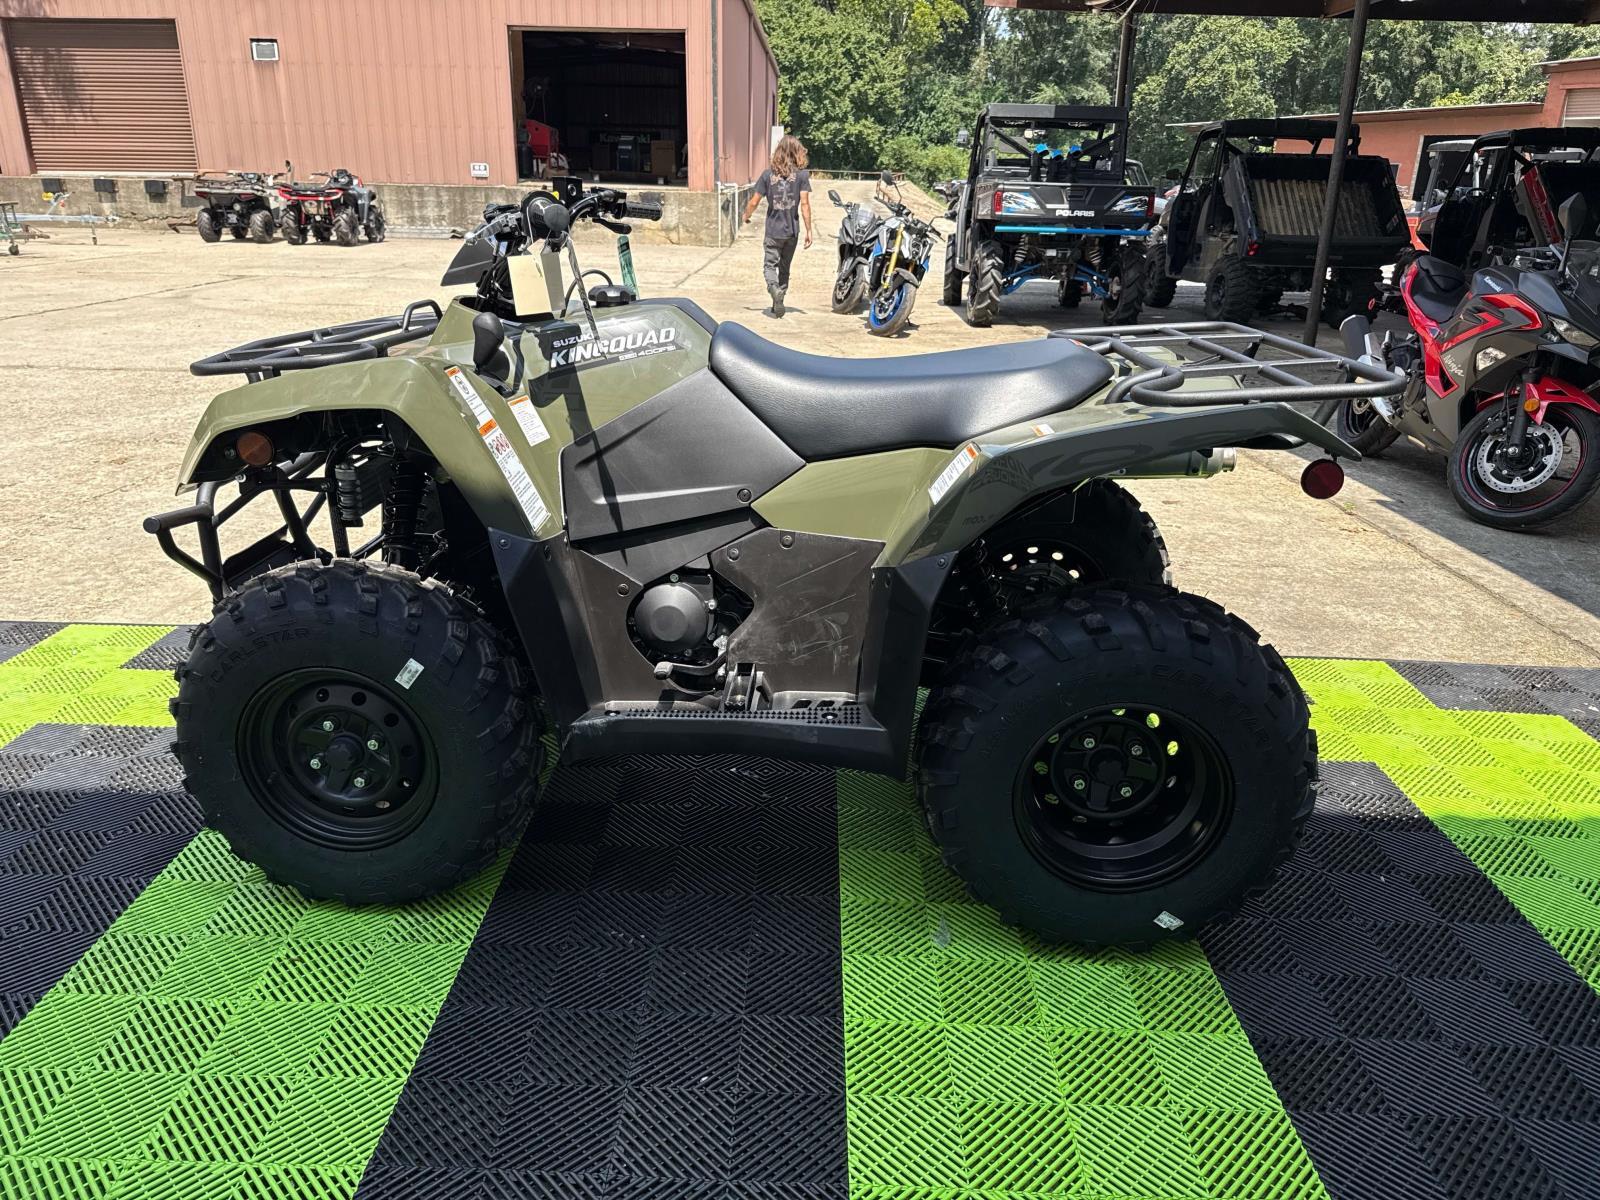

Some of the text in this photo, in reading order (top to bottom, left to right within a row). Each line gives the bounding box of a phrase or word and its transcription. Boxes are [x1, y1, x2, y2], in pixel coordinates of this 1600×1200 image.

[1055, 209, 1095, 217] POLARIS
[551, 327, 675, 369] KINGQUAD
[553, 333, 596, 348] SUZUK
[1443, 354, 1465, 377] Ninja
